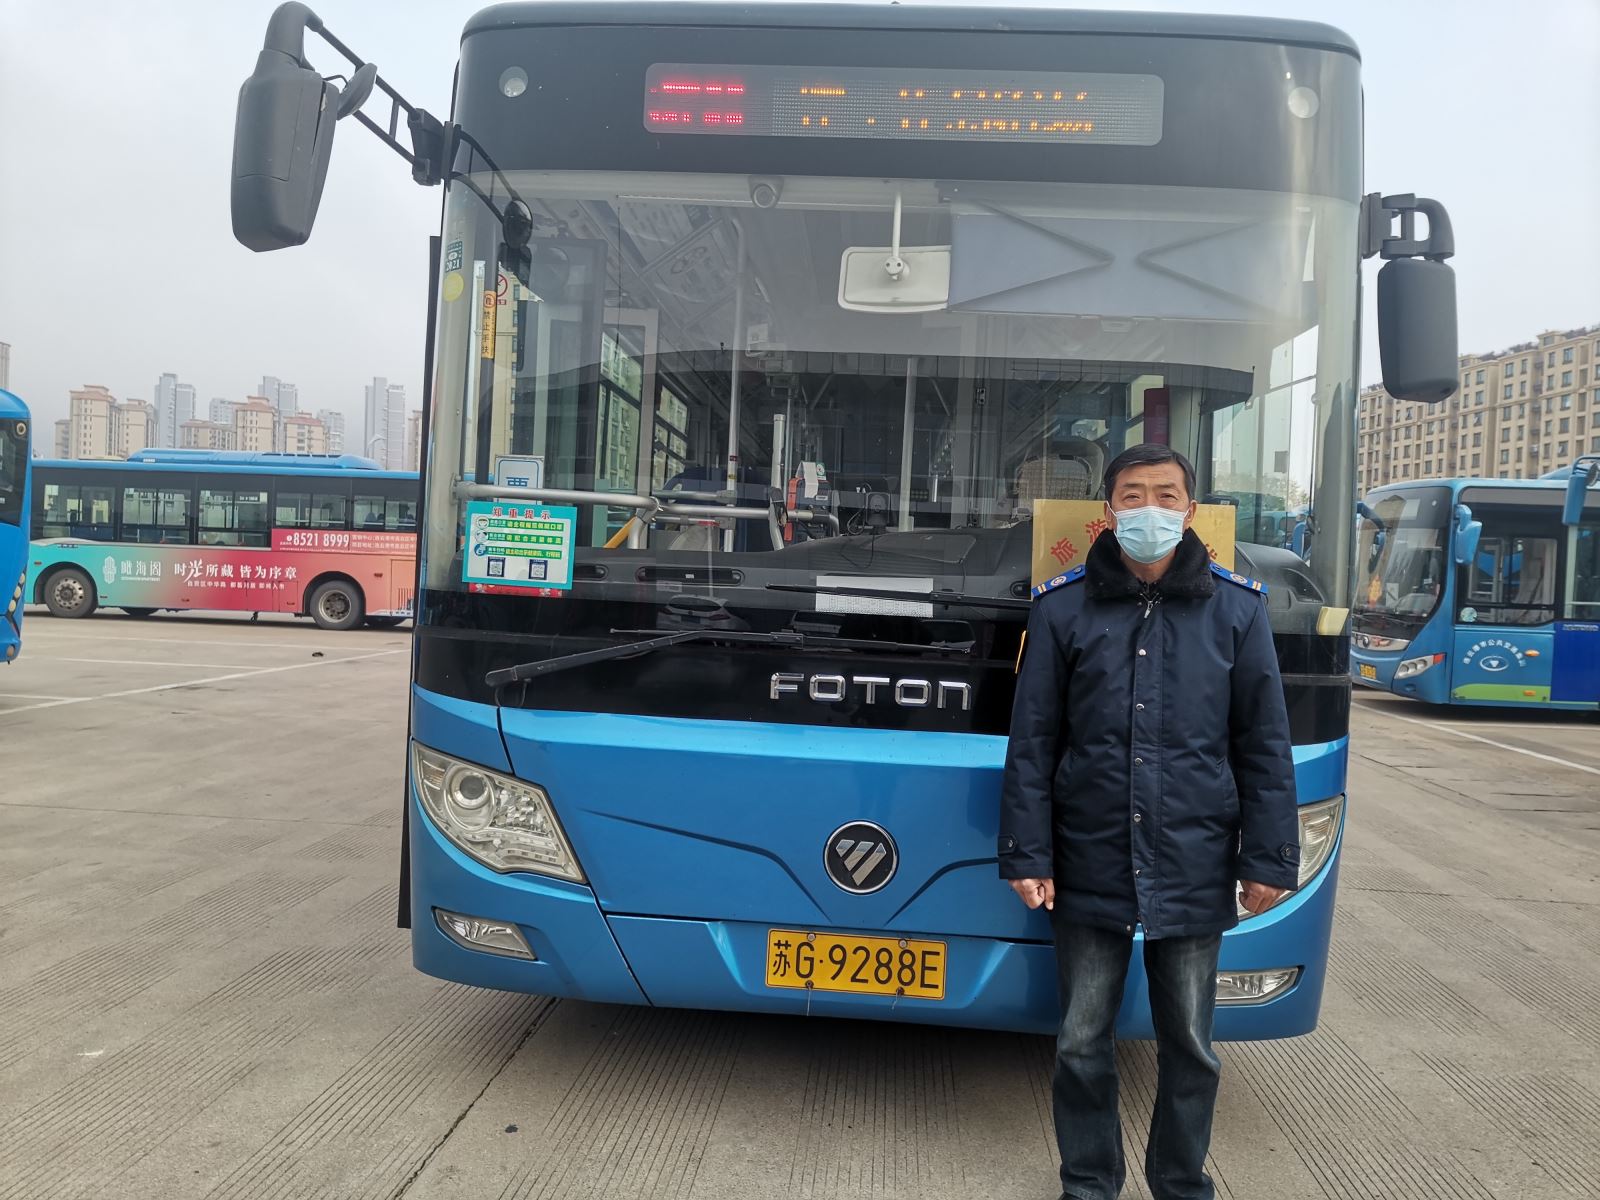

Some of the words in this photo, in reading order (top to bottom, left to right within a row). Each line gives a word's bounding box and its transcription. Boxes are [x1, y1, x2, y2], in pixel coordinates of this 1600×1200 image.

[293, 532, 319, 546] 8521
[323, 533, 349, 547] 8999
[174, 559, 234, 583] 时光所藏
[240, 565, 297, 580] 皆为序章
[770, 672, 972, 711] FOTON
[773, 940, 940, 989] 苏G·9288E
